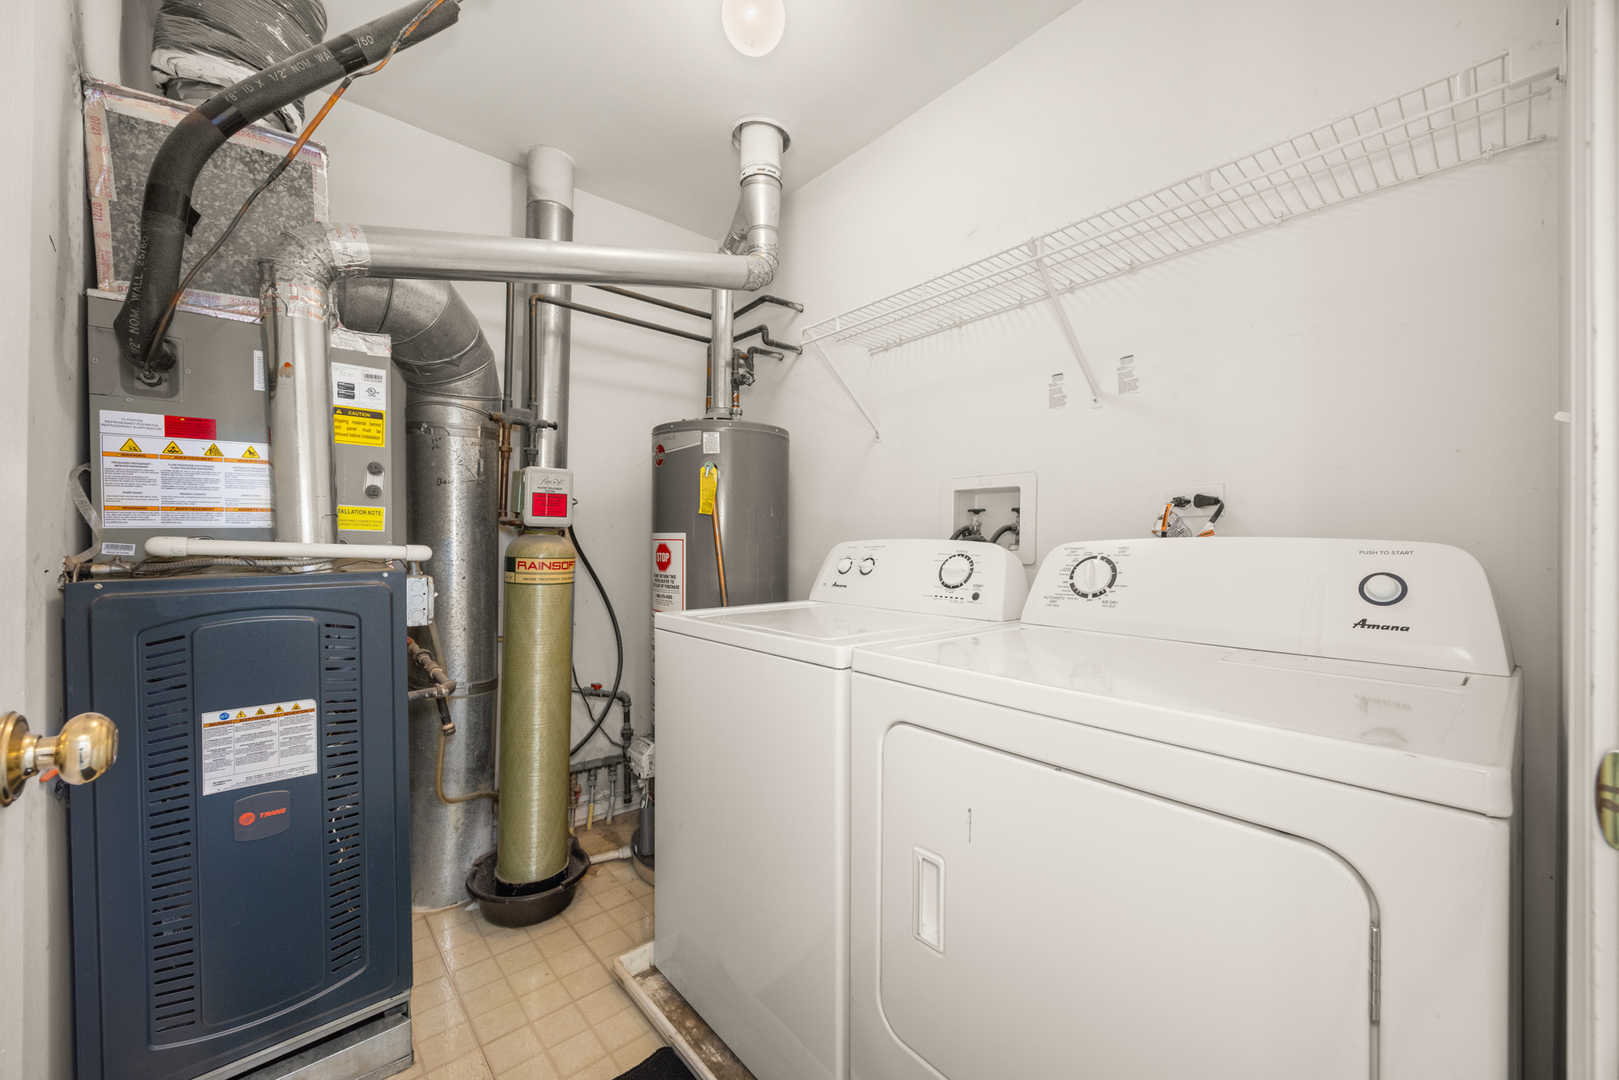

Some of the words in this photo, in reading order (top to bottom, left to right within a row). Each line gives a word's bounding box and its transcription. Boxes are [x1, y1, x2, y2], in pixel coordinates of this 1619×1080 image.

[242, 84, 254, 94] ID
[254, 79, 266, 88] X
[268, 68, 287, 82] 1/2"
[356, 34, 374, 49] /50
[90, 116, 102, 136] 07/21
[302, 148, 322, 158] 07/21
[92, 202, 104, 222] 07/21
[130, 274, 144, 302] WALL
[657, 552, 669, 562] STOP
[1352, 618, 1410, 632] Amana
[259, 808, 287, 818] TRANE
